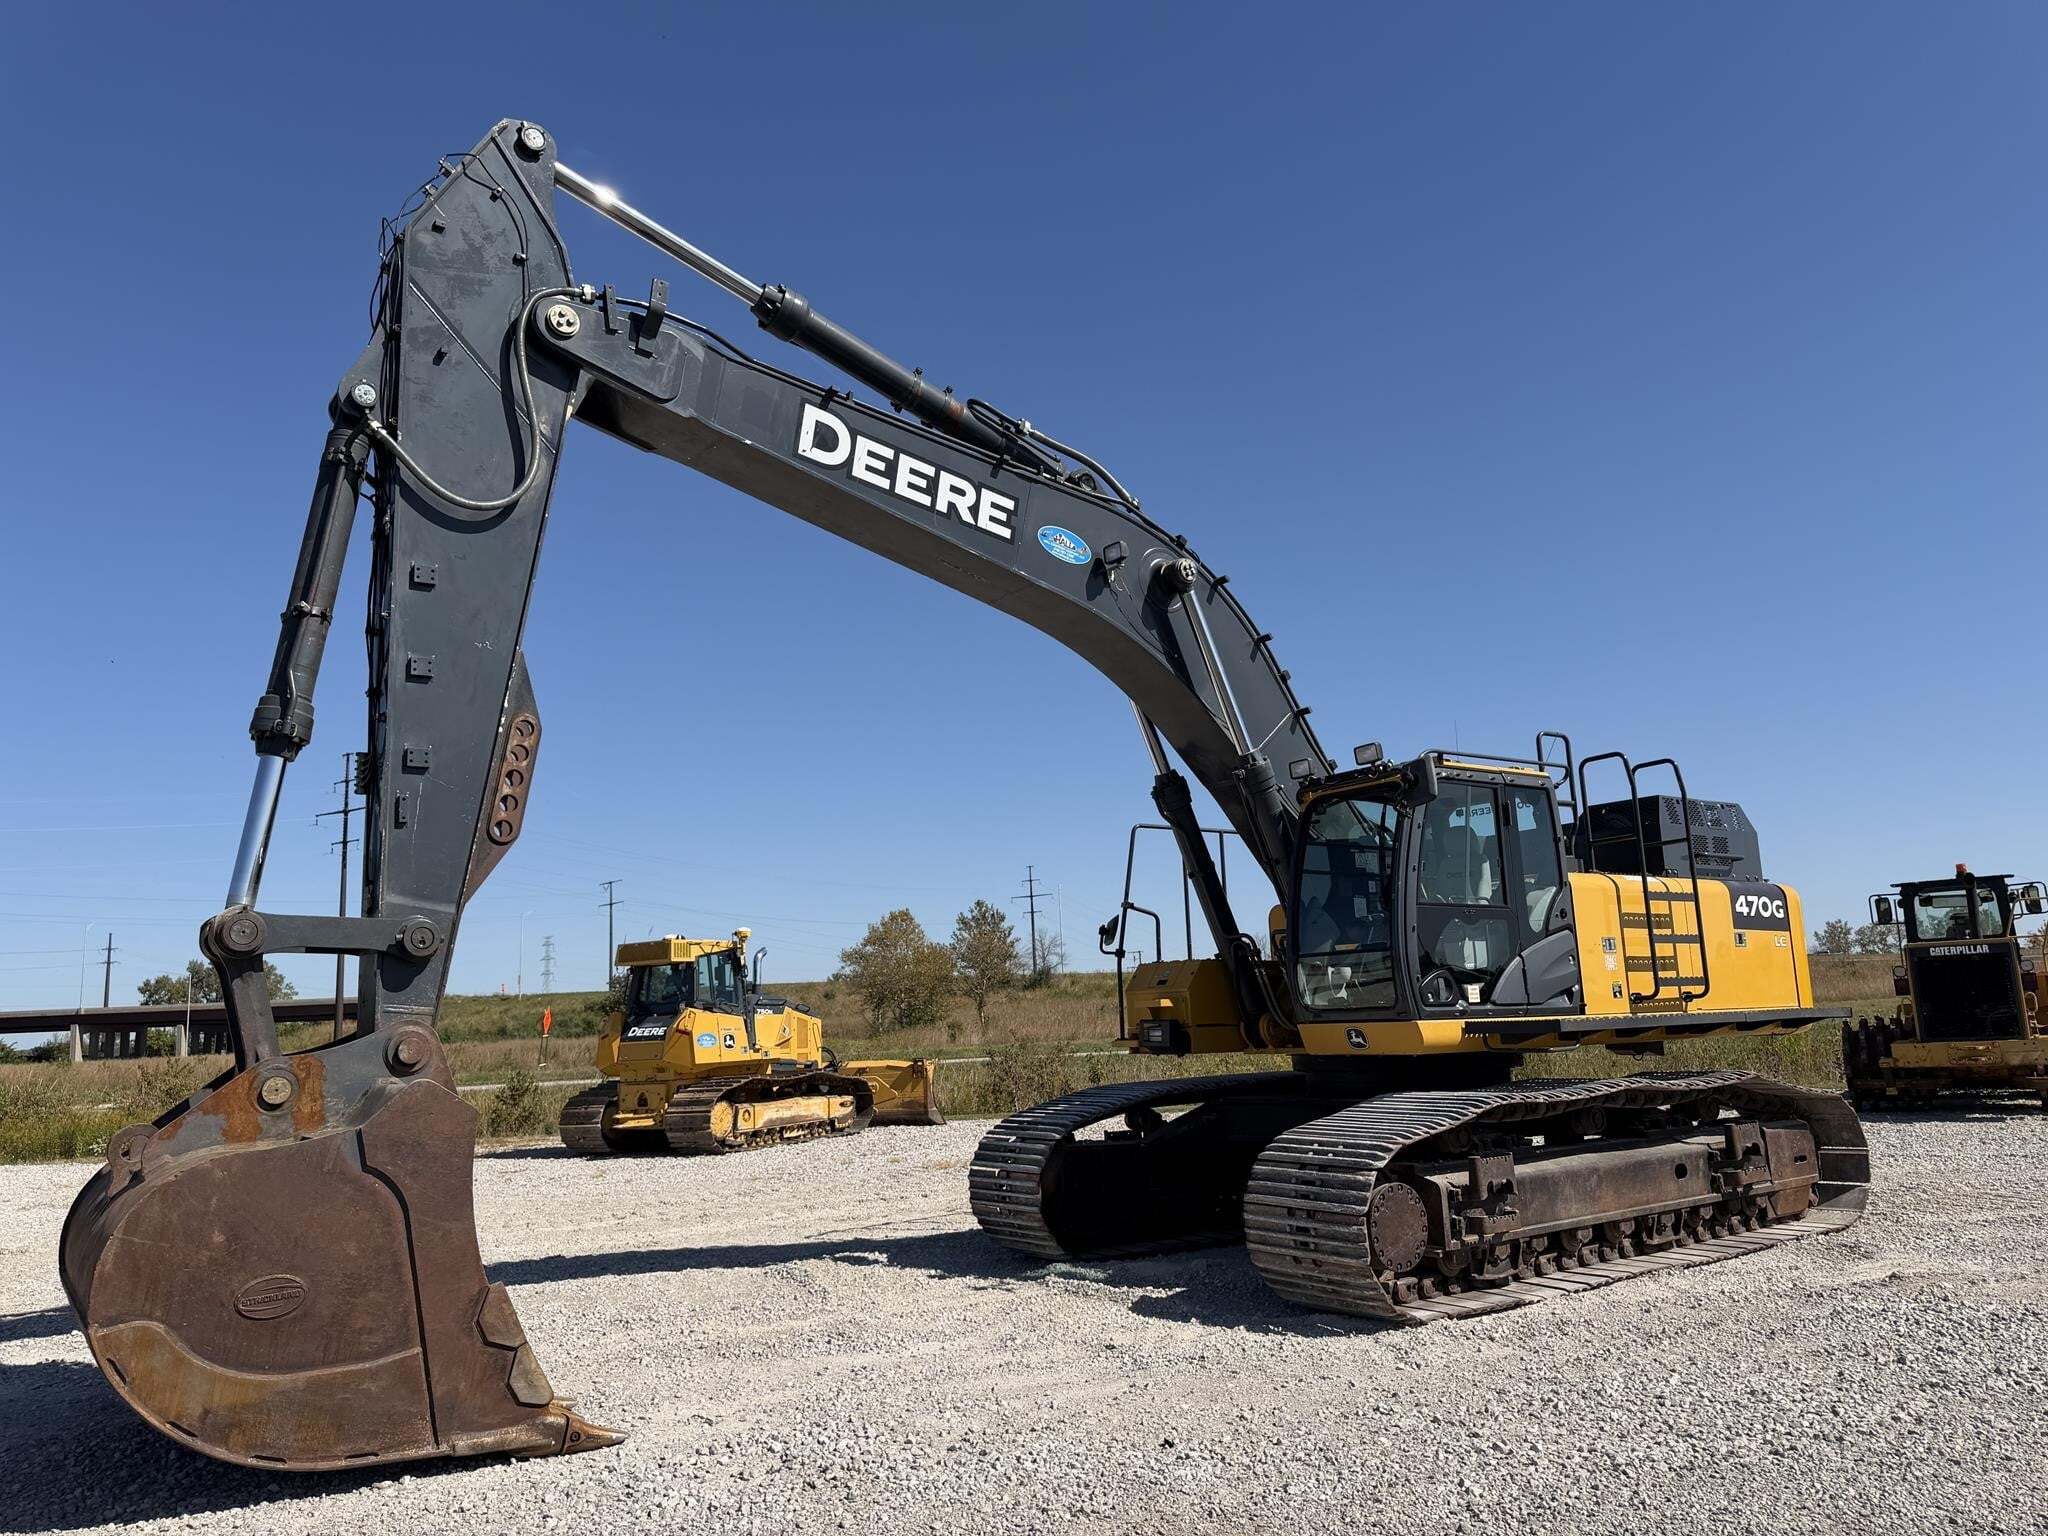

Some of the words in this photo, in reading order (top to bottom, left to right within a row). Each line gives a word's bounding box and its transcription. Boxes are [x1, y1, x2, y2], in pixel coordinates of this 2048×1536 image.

[798, 403, 1015, 539] DEERE
[1735, 895, 1785, 919] 470G
[1930, 945, 1990, 956] CATERPILLAR
[627, 1027, 667, 1037] DEERE
